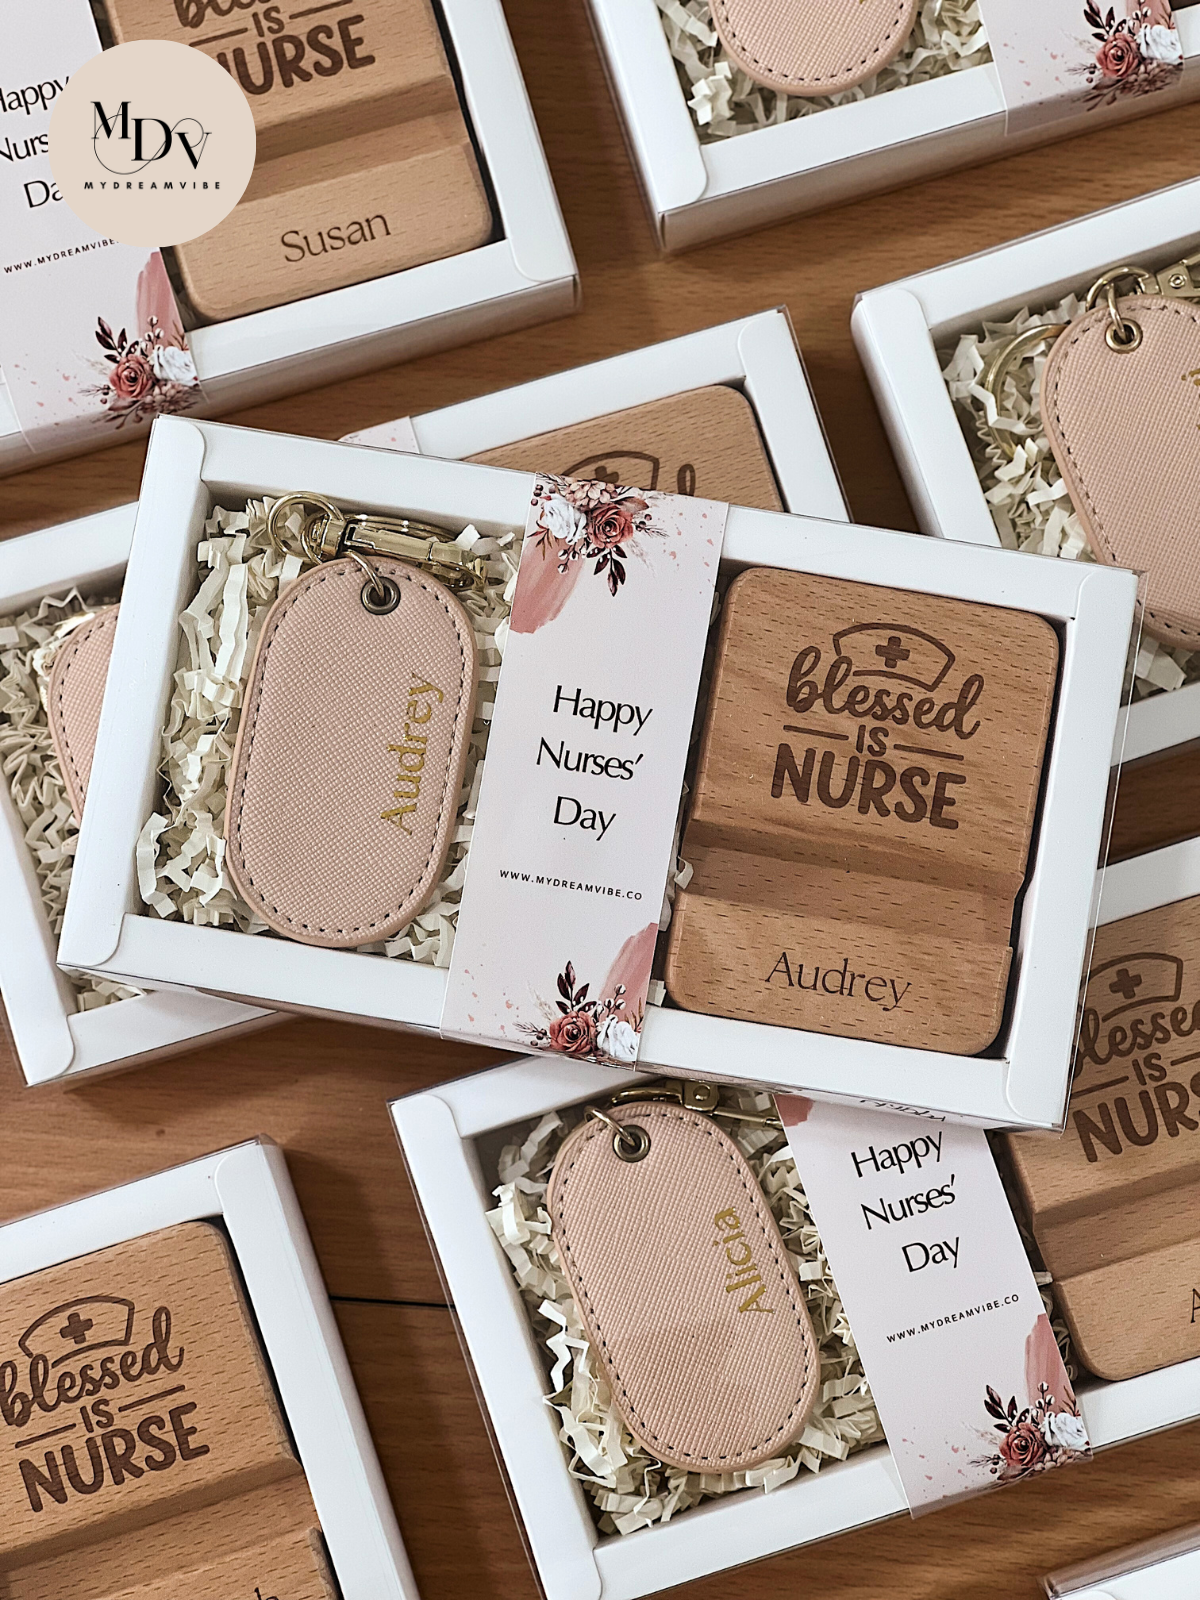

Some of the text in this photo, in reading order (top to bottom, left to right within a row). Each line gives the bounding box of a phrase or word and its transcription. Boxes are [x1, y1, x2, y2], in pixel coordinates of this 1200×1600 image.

[252, 6, 285, 38] IS
[216, 14, 376, 95] URSE
[281, 214, 391, 263] Susan
[553, 685, 653, 736] Happy
[786, 646, 985, 740] blessed
[380, 672, 444, 836] Audrey
[856, 724, 890, 757] IS
[770, 743, 966, 830] NURSE
[553, 796, 617, 841] Day
[500, 869, 643, 900] WWW.MYDREAMVIBE.CO
[764, 951, 912, 1012] Audrey
[1073, 1000, 1200, 1079] lesse
[1132, 1052, 1167, 1086] IS
[1072, 1072, 1200, 1163] NUR
[851, 1131, 943, 1178] Happy
[713, 1207, 774, 1314] Alicia
[902, 1237, 960, 1273] Day
[887, 1294, 1020, 1343] WWW.MYDREAMVIBE.CO
[0, 1306, 185, 1428] blessed
[80, 1399, 115, 1433] IS
[18, 1401, 210, 1513] NURSE
